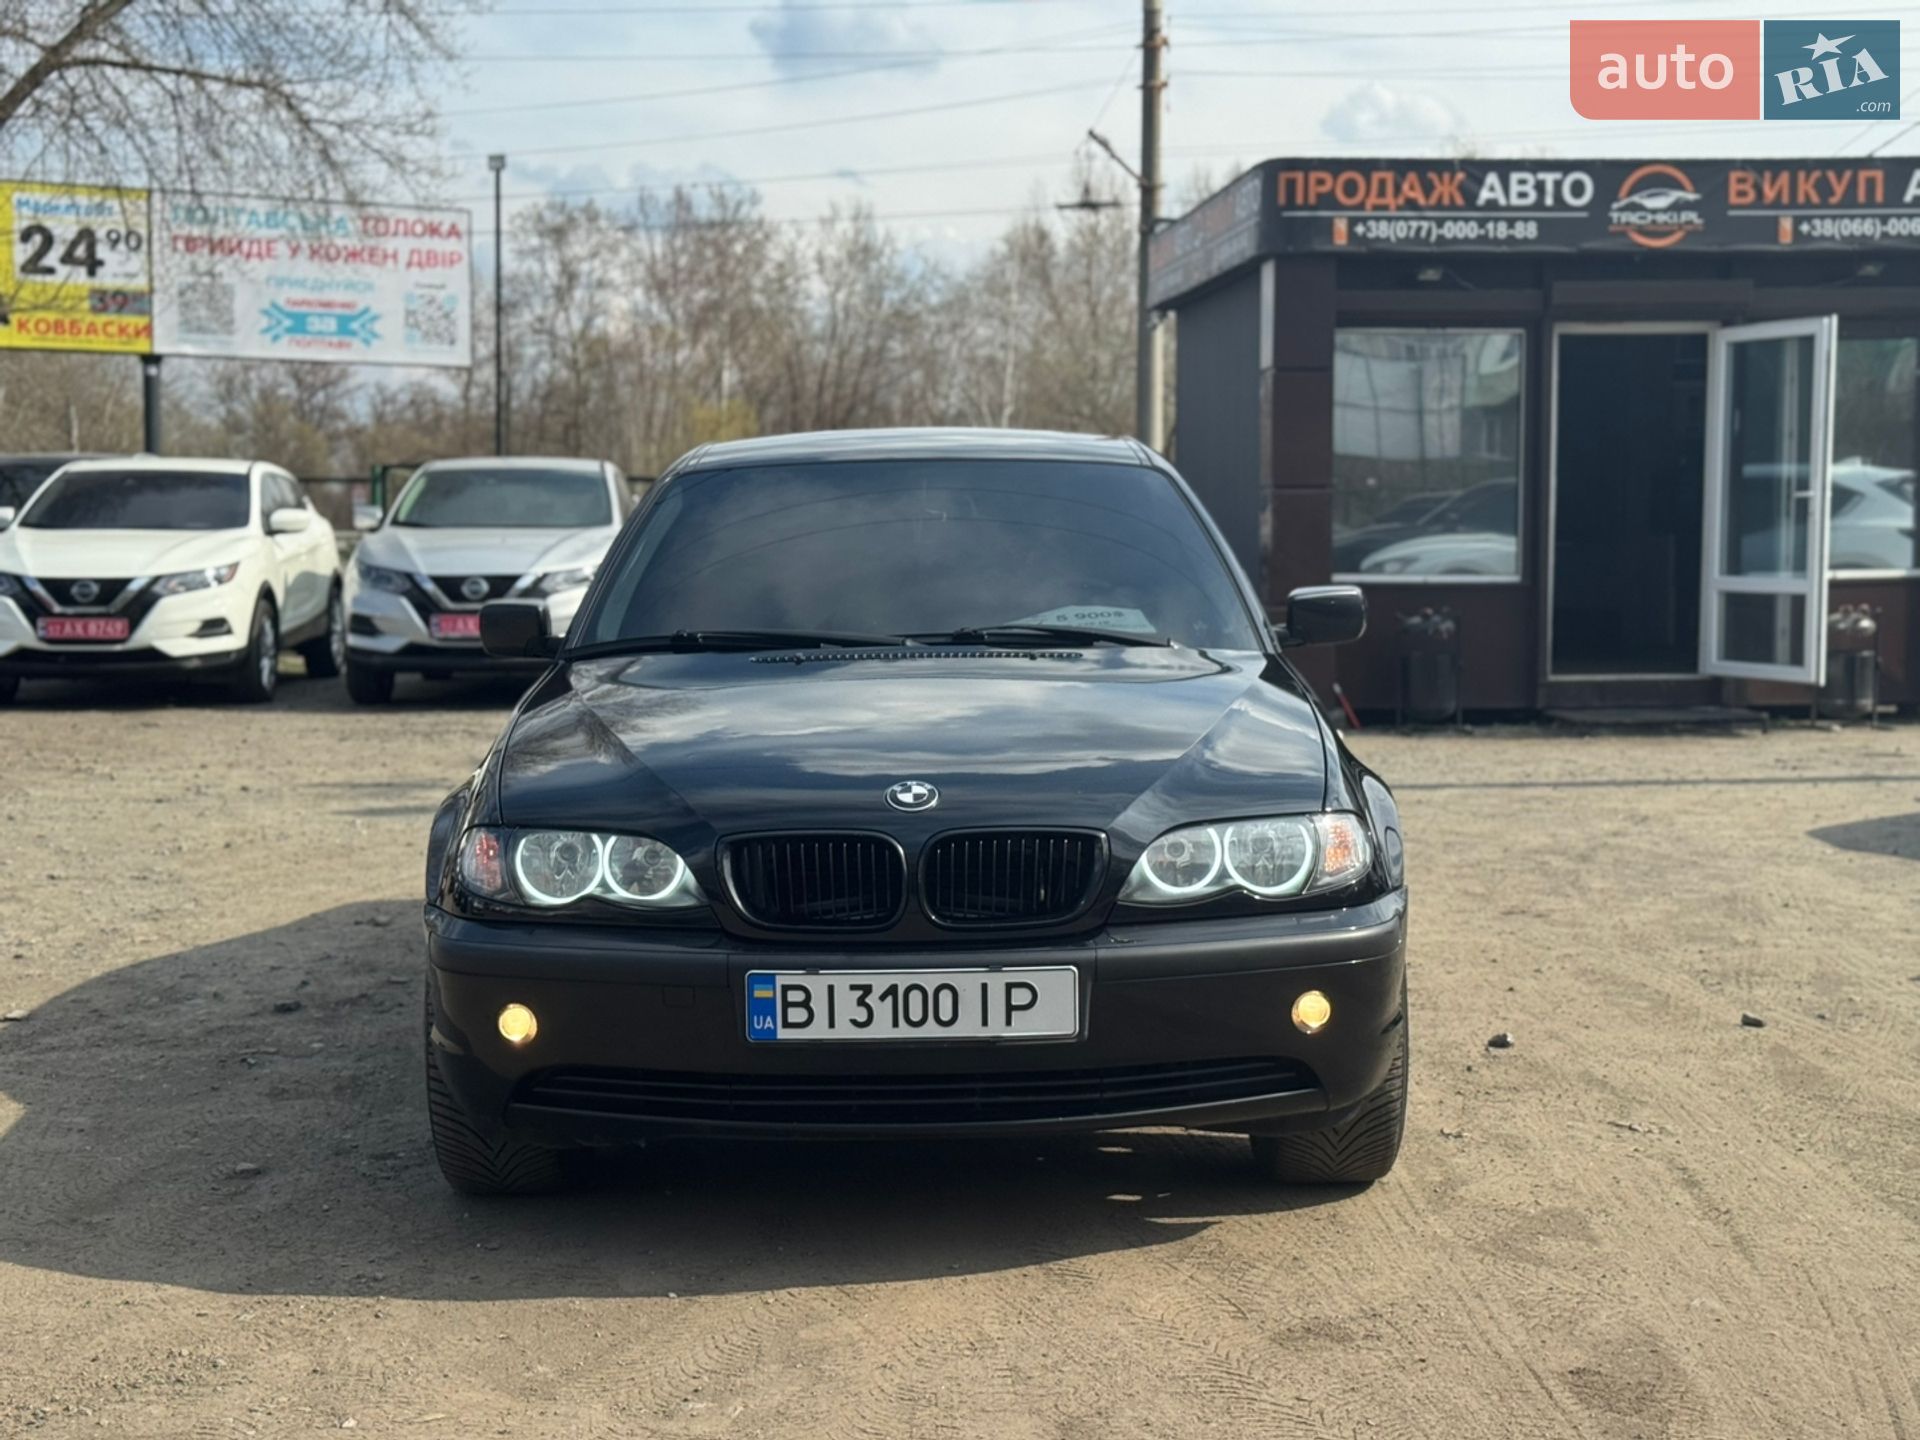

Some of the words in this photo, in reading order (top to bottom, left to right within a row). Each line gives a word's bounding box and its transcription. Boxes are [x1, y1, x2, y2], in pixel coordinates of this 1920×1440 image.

[1277, 171, 1466, 212] ПРОДАЖ
[1476, 171, 1594, 207] АВТО
[1728, 169, 1885, 205] ВИКУП
[360, 214, 462, 240] ТОЛОКА
[1354, 219, 1538, 242] +38(077)-000-18-88
[20, 224, 104, 276] 24
[308, 243, 398, 268] КОЖЕН
[406, 248, 463, 270] ДВІР
[16, 317, 152, 337] КОВБАСКИ
[754, 1015, 774, 1030] UA
